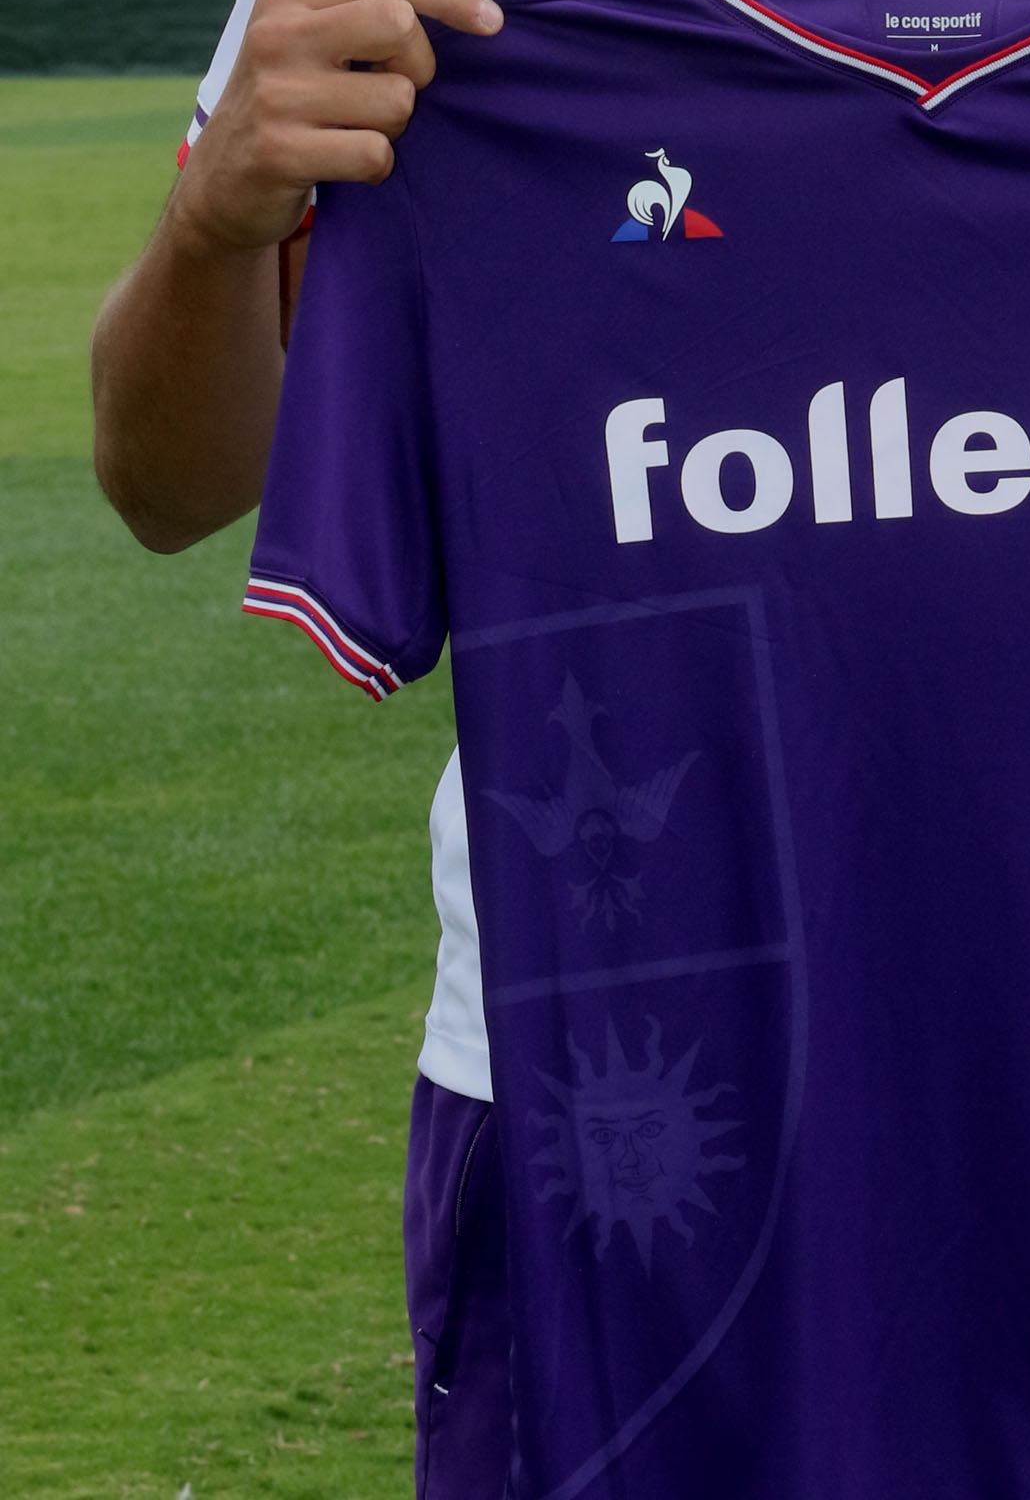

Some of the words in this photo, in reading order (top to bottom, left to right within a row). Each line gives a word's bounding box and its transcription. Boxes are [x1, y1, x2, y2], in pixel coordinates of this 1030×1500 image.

[885, 12, 900, 29] le
[901, 16, 930, 32] coq
[932, 12, 982, 32] sportif
[930, 43, 939, 52] M
